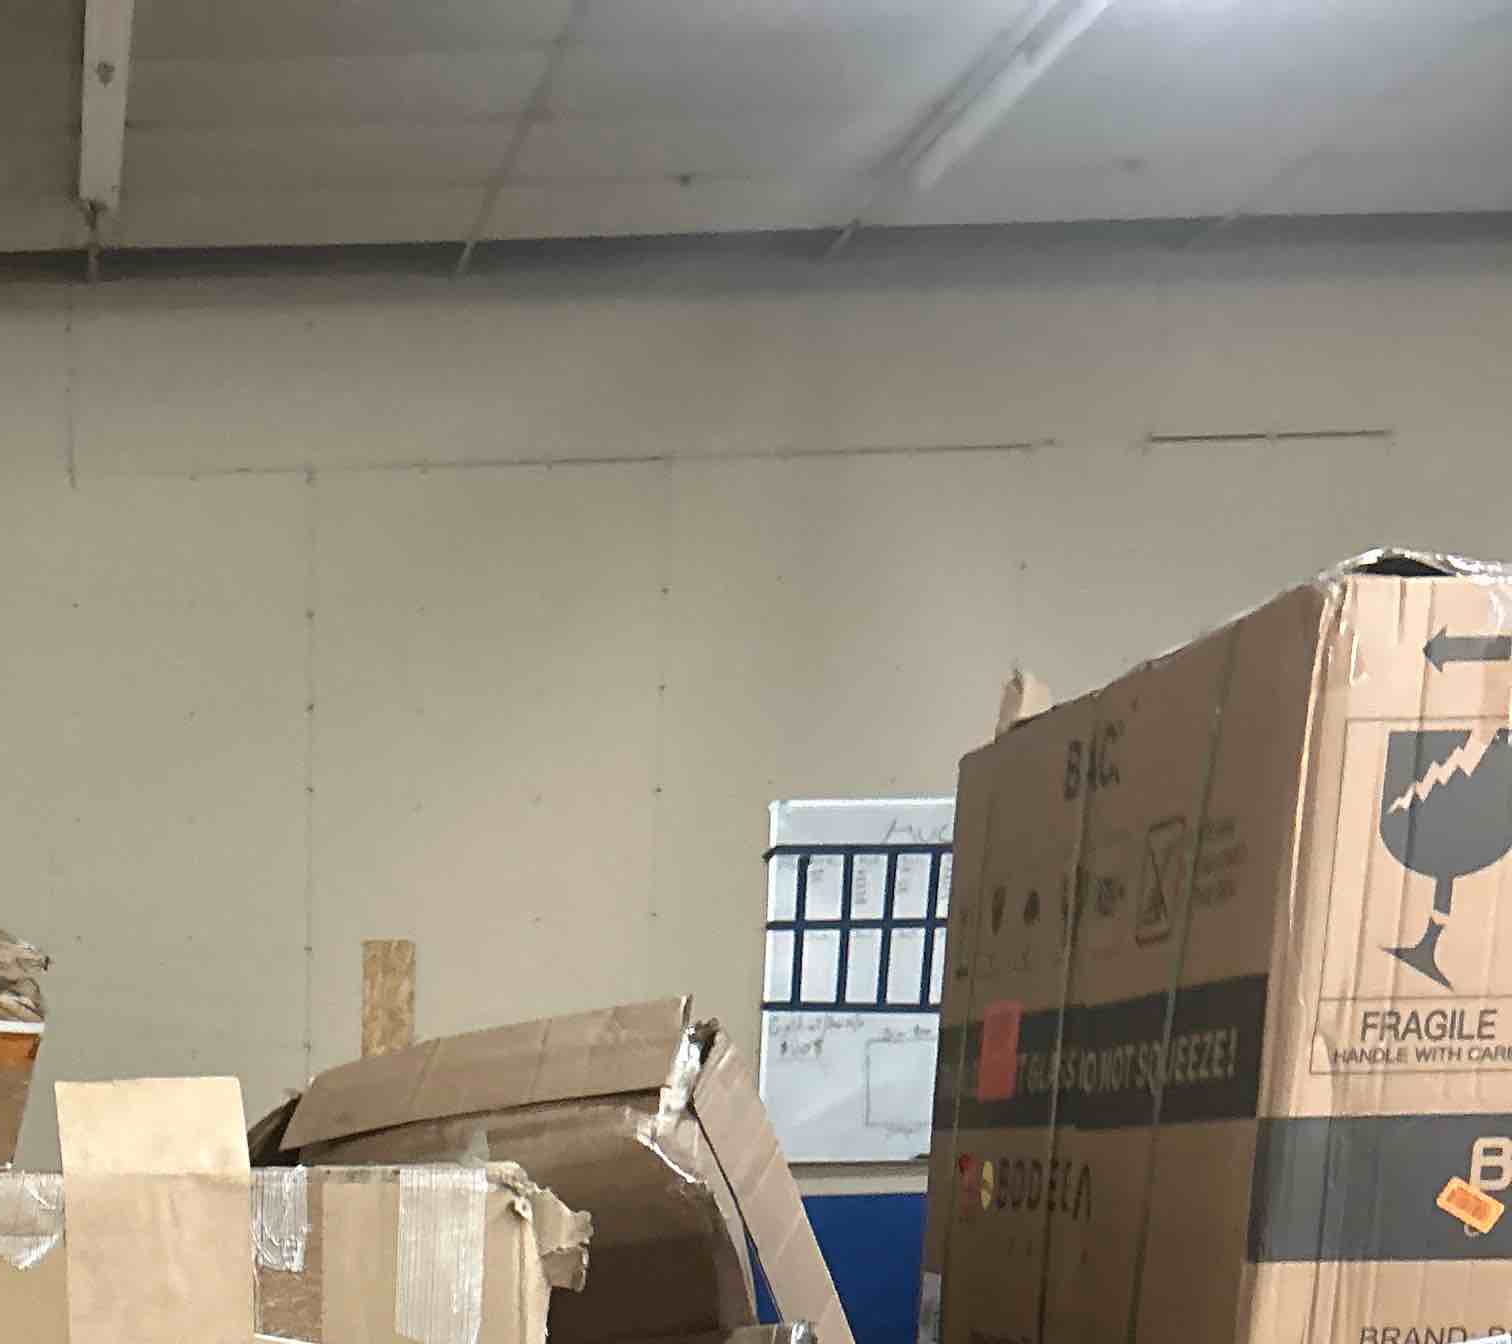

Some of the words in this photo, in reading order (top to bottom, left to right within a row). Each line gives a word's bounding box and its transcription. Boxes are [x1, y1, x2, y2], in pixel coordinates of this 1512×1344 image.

[1360, 1008, 1498, 1042] FRAGILE
[1333, 1048, 1409, 1065] HANDLE
[1415, 1047, 1462, 1063] WITH
